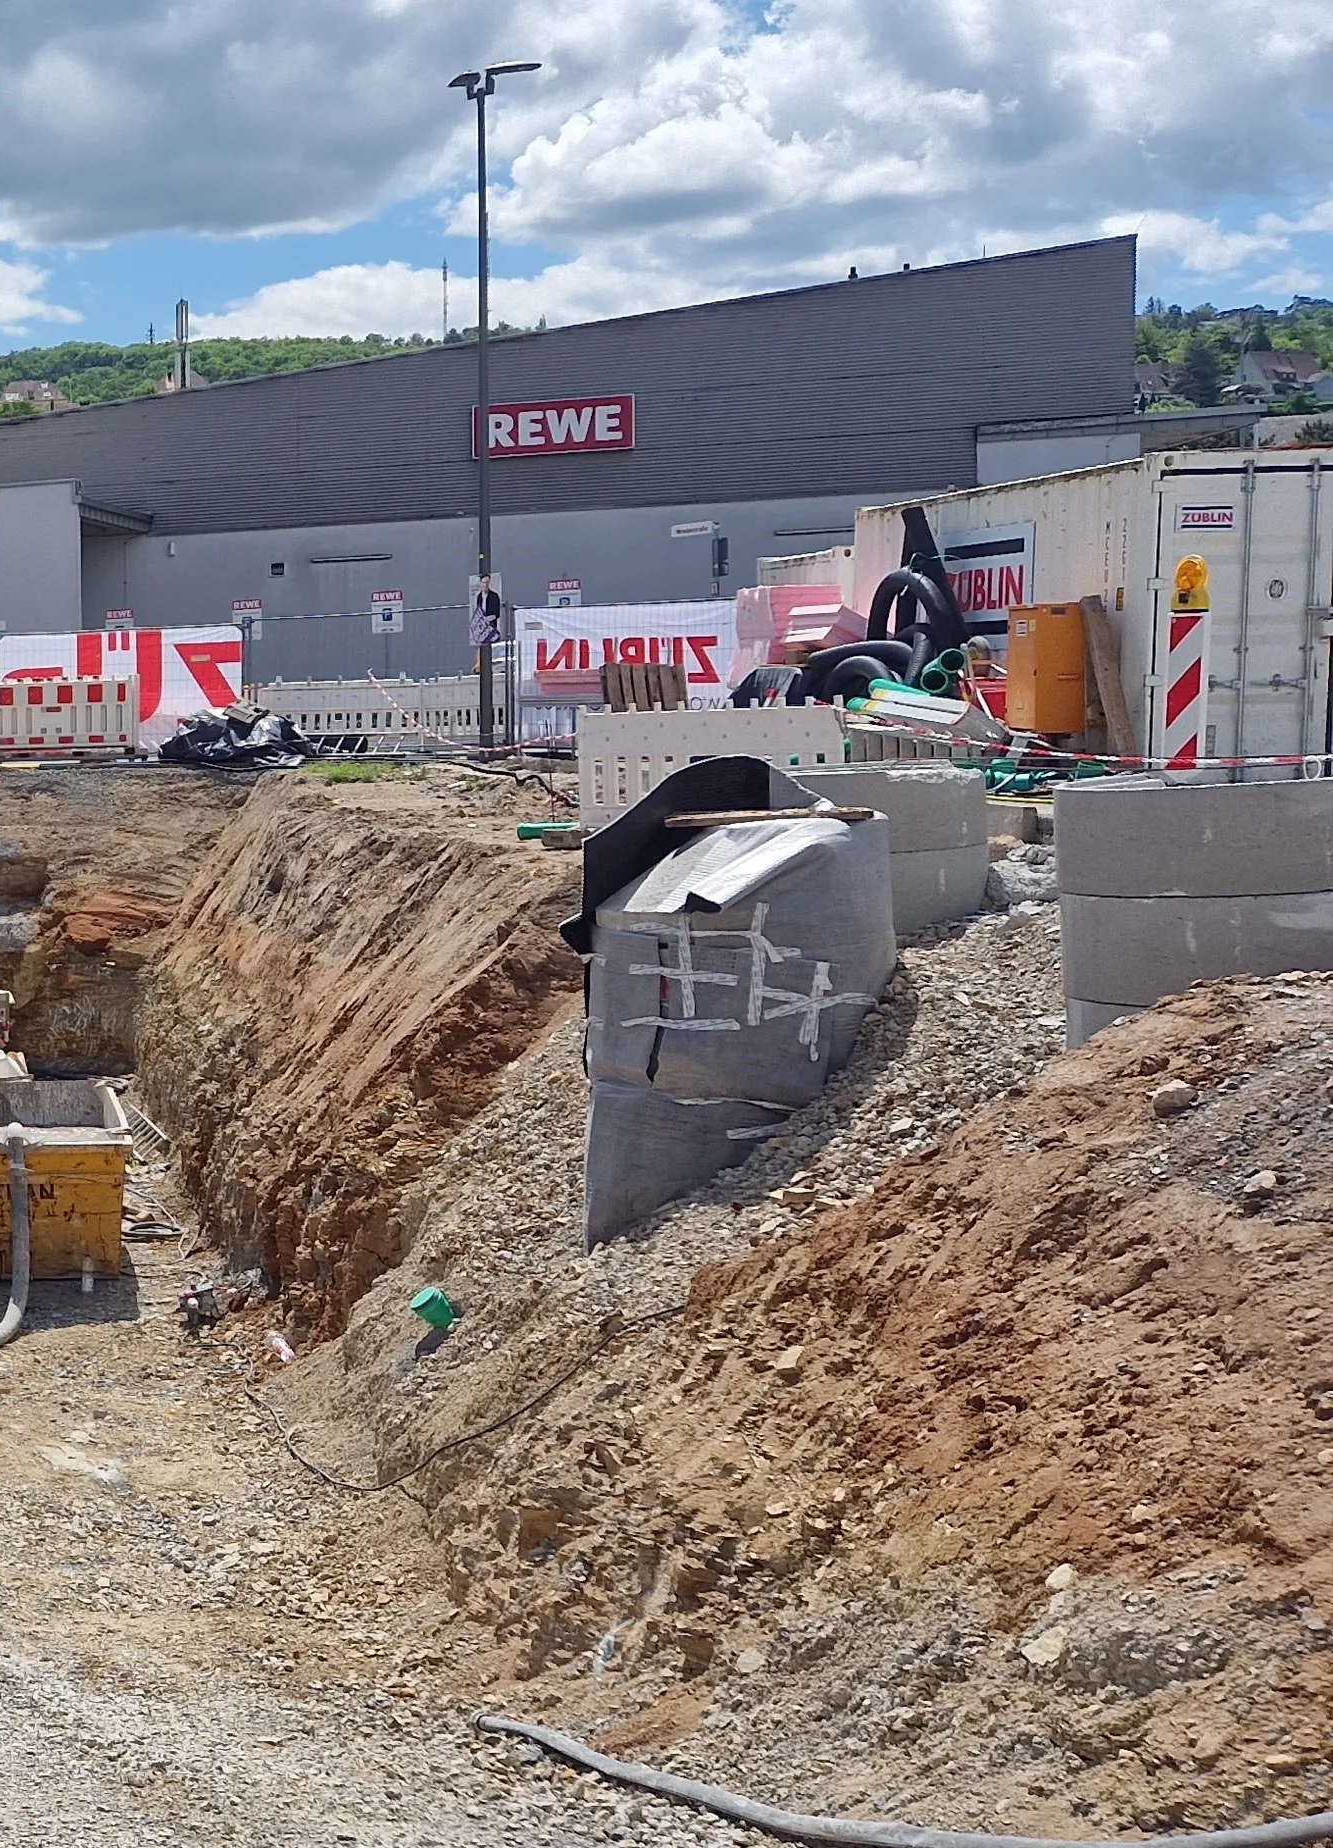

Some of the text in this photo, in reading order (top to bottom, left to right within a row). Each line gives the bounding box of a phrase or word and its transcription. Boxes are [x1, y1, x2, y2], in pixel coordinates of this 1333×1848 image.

[488, 404, 623, 449] REWE
[549, 580, 580, 590] REWE
[373, 591, 402, 601] REWE
[234, 600, 261, 609] REWE
[106, 610, 133, 619] REWE
